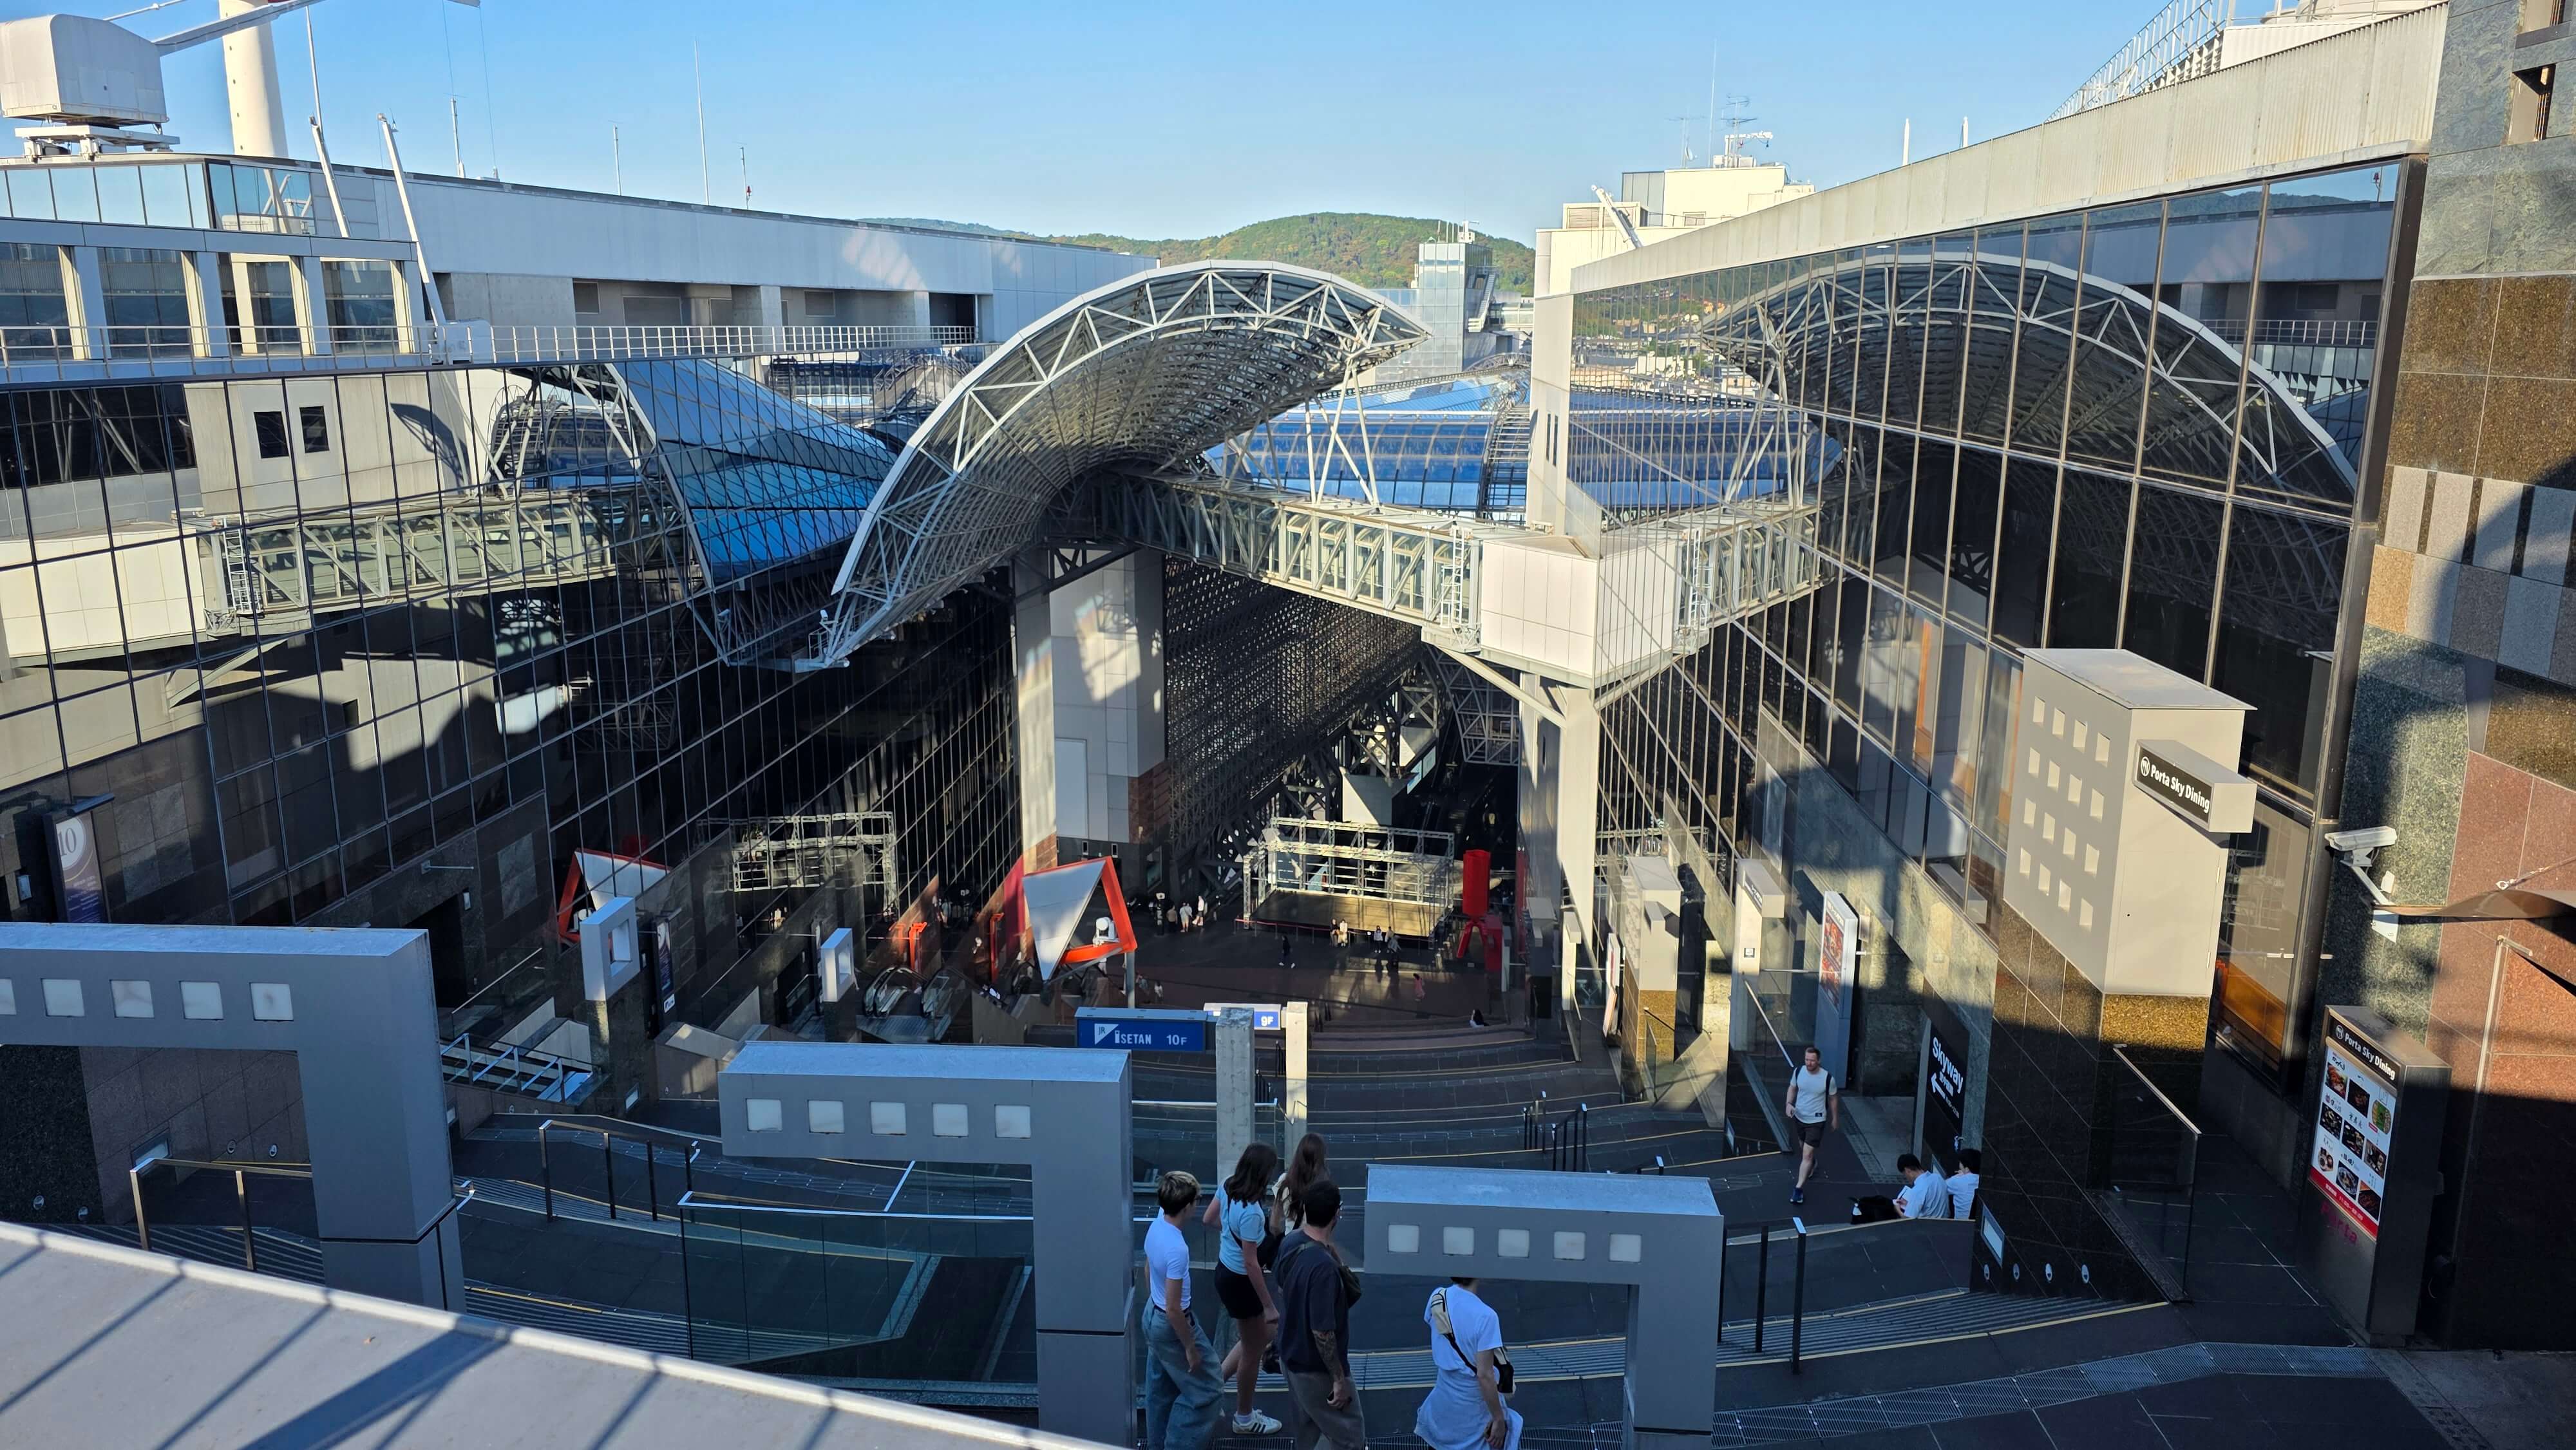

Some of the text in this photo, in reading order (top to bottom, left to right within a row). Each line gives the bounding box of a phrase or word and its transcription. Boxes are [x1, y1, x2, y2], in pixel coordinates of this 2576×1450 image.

[2151, 764, 2210, 814] Porta Sky Dining
[58, 828, 77, 856] 10
[1098, 1026, 1106, 1035] JR
[1166, 1035, 1188, 1046] 10F
[1261, 1015, 1274, 1026] 9F
[1933, 1037, 1964, 1094] Skyway
[2344, 1033, 2396, 1081] Porta Sky Dining
